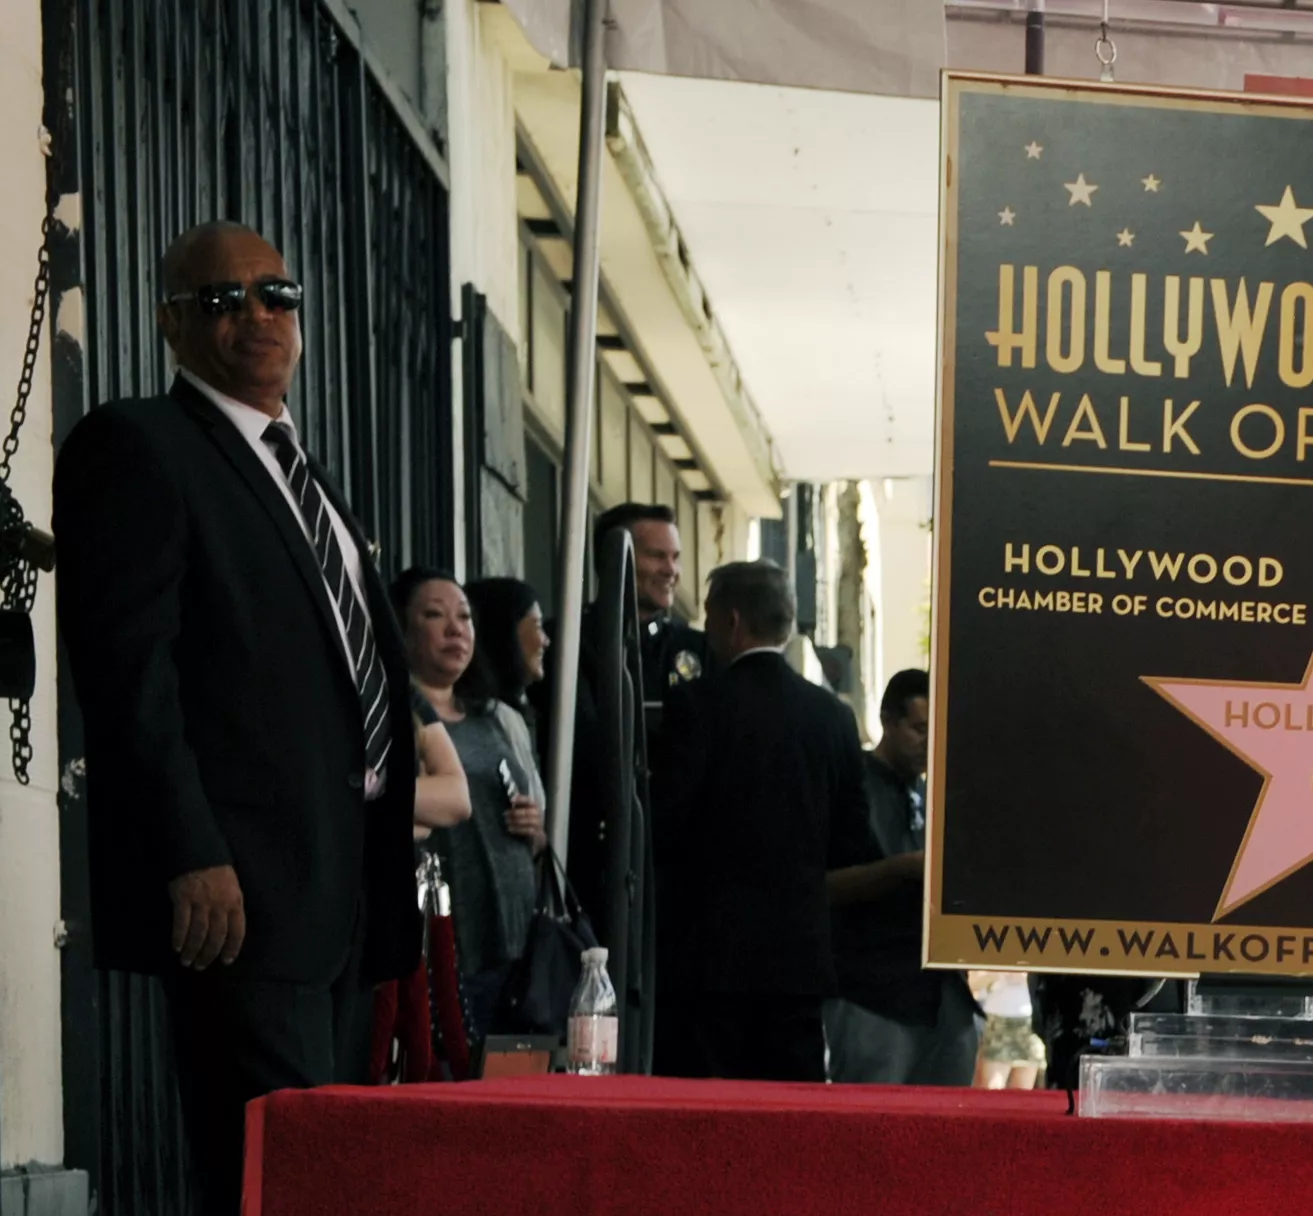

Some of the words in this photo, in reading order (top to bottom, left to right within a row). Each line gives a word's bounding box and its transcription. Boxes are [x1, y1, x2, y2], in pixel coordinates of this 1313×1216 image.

[995, 388, 1200, 454] WALK
[1005, 543, 1283, 586] HOLLYWOOD
[979, 587, 1102, 613] CHAMBER
[1112, 595, 1147, 615] OF
[1156, 597, 1306, 624] COMMERCE
